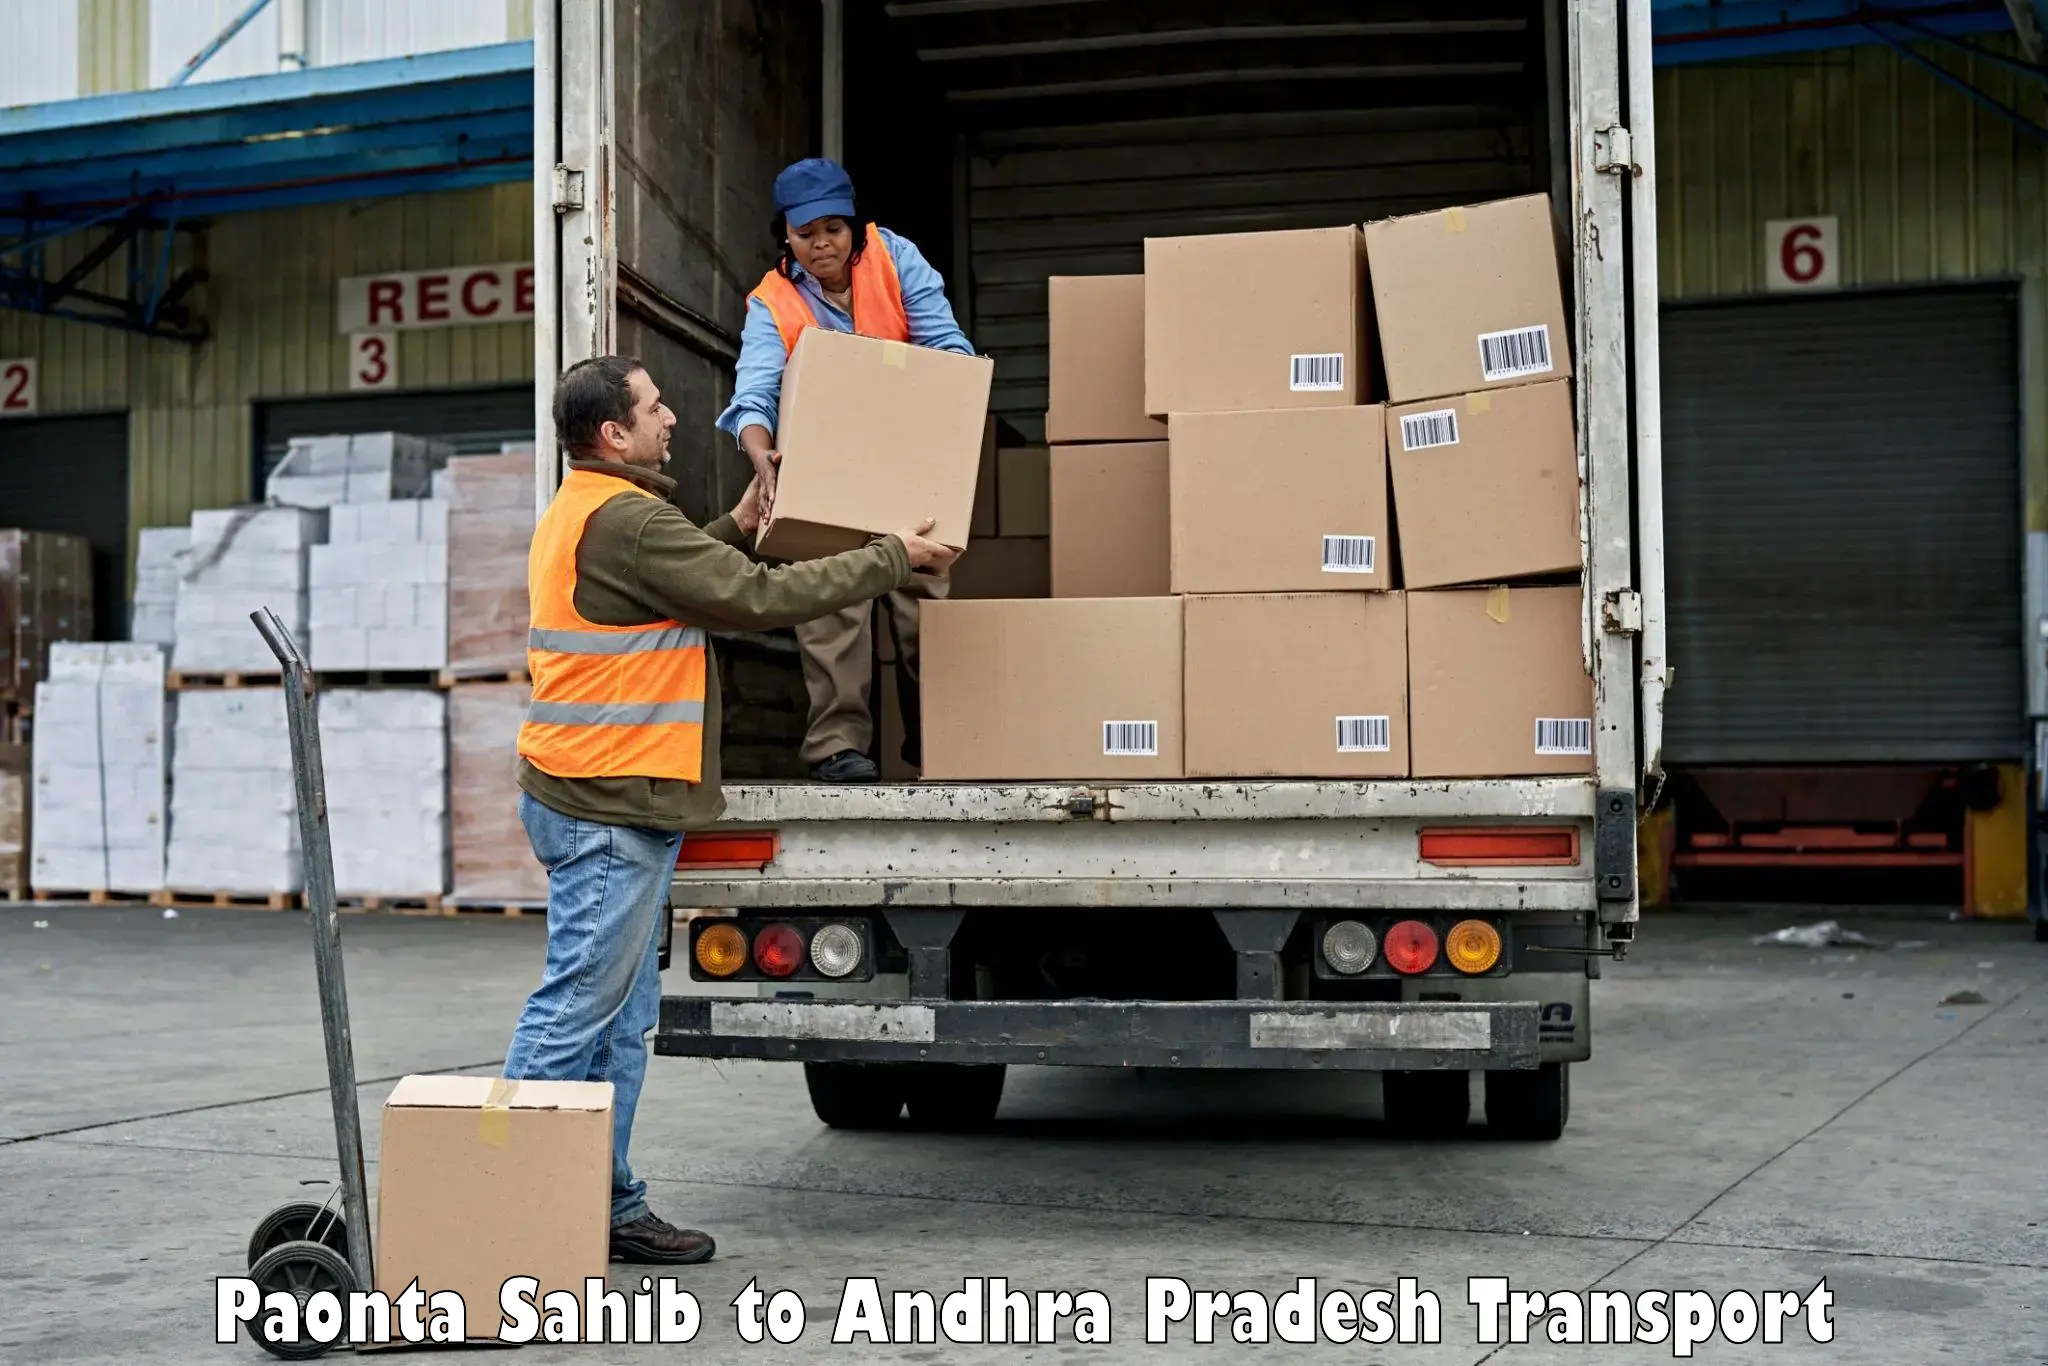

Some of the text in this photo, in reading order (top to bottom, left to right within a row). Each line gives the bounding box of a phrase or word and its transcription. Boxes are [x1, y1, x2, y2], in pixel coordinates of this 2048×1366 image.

[1779, 225, 1825, 285] 6
[358, 335, 389, 386] 3
[3, 364, 29, 409] 2
